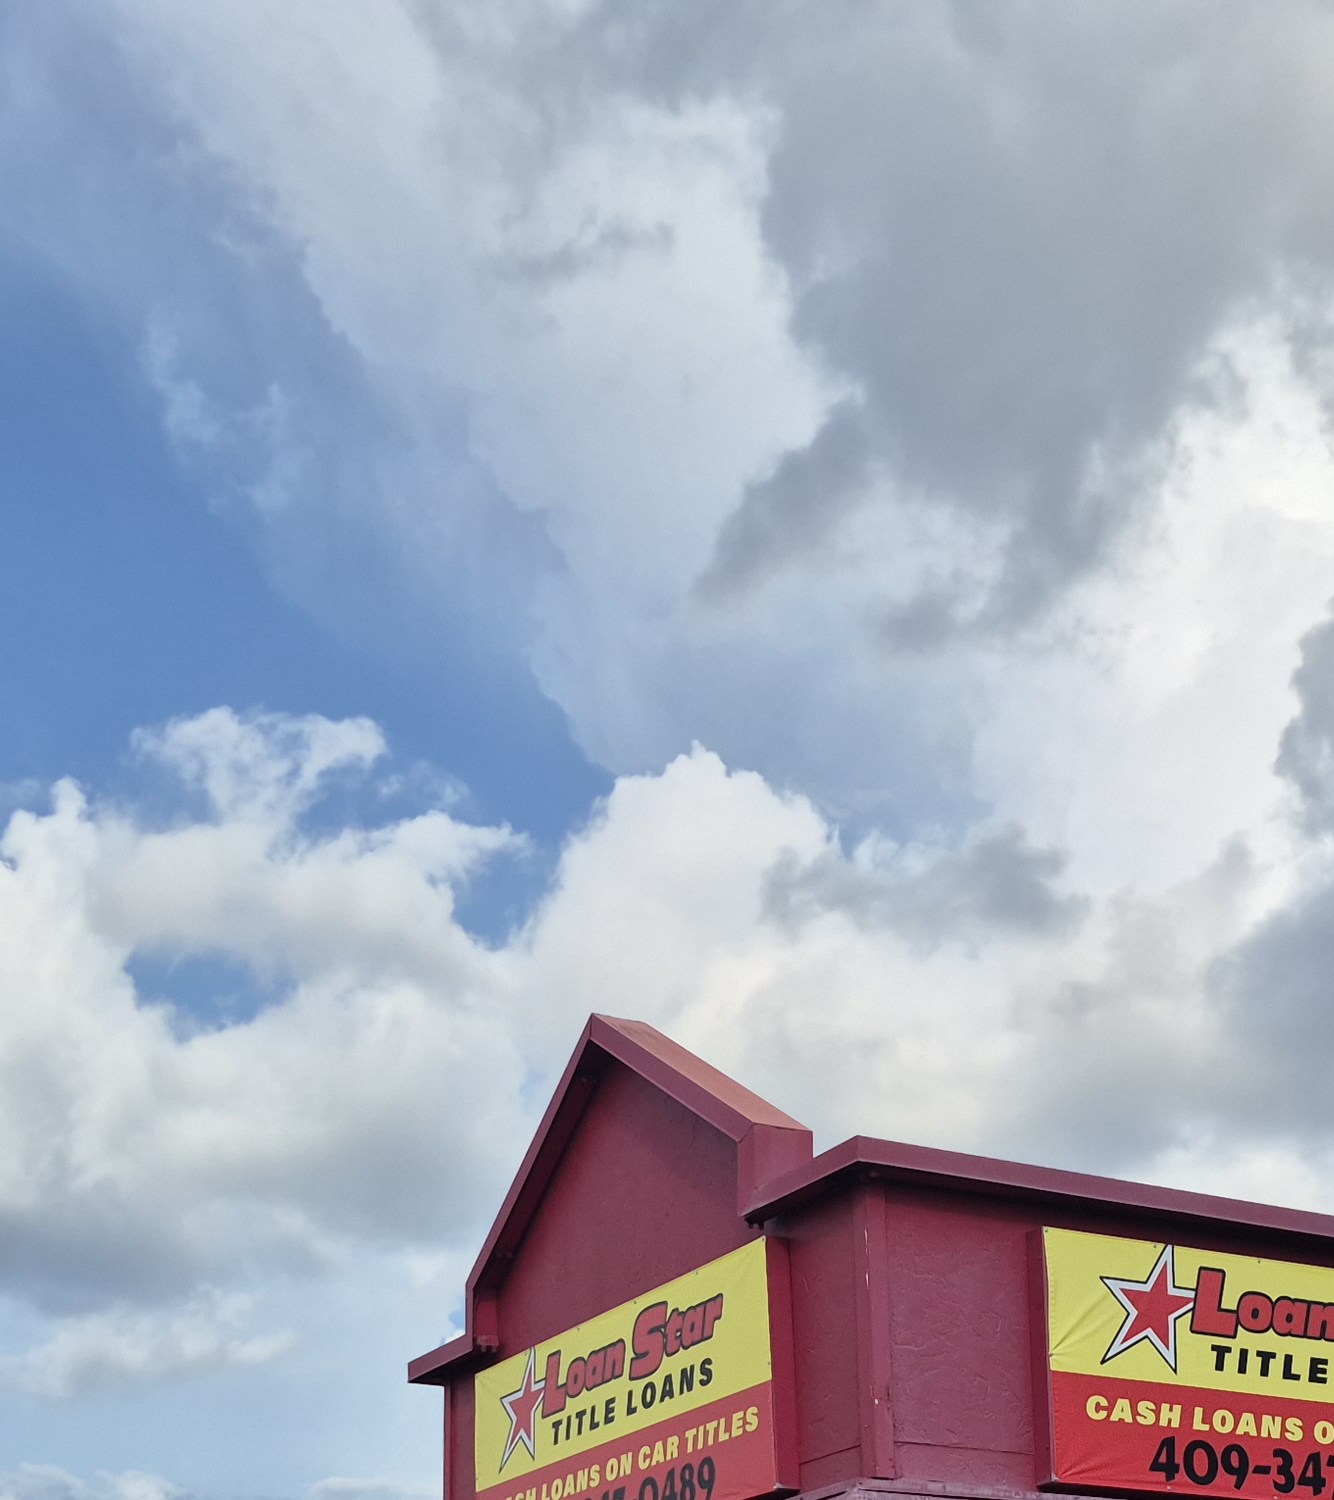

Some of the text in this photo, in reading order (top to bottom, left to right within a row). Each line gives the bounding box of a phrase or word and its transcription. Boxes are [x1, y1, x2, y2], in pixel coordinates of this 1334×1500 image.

[541, 1293, 724, 1419] Loan Star
[1211, 1344, 1329, 1384] TITLE
[552, 1358, 713, 1445] TITLE LOANS
[1086, 1395, 1182, 1429] CASH
[1192, 1406, 1304, 1441] LOANS
[605, 1452, 633, 1482] ON
[638, 1435, 679, 1471] CAR
[685, 1406, 759, 1454] TITLES
